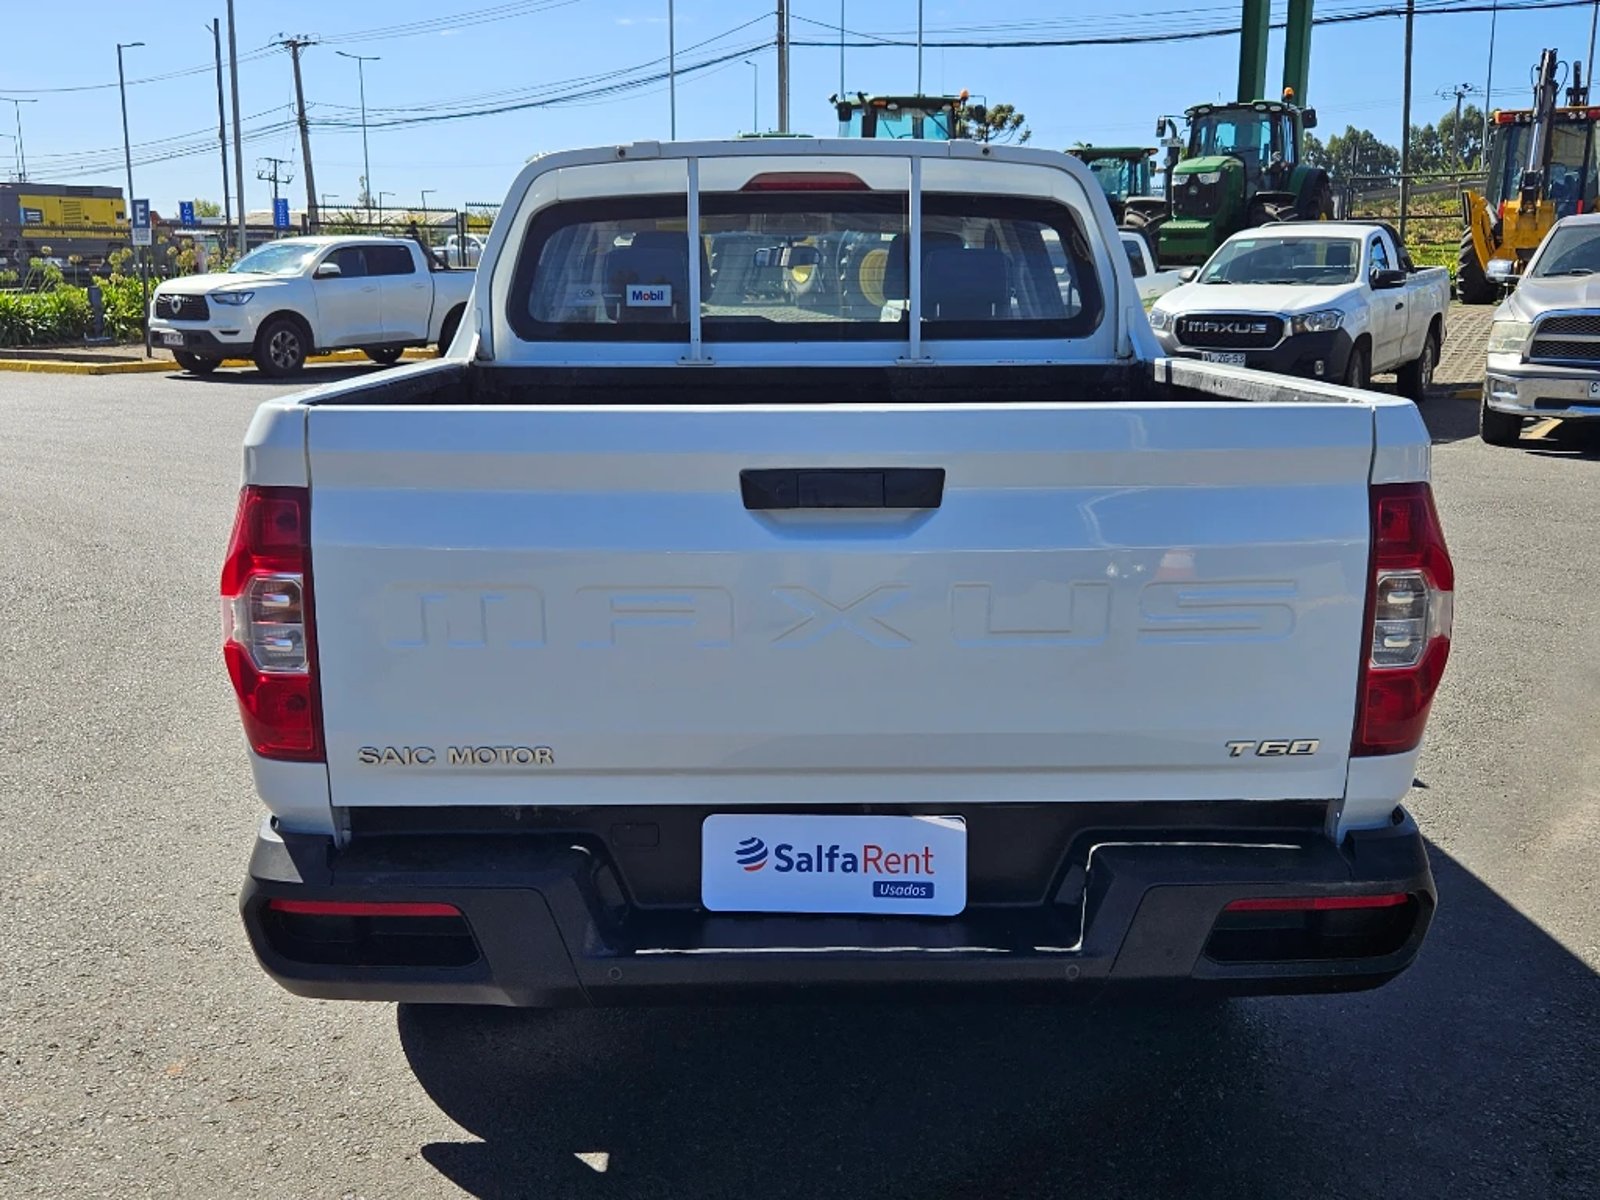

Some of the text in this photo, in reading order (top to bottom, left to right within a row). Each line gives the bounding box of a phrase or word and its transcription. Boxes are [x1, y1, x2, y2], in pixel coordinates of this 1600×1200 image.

[136, 204, 146, 225] E
[632, 290, 664, 301] Mobil
[1188, 321, 1267, 333] MAXUS
[384, 579, 1298, 648] MAXUS
[358, 746, 554, 765] SAIC MOTOR
[1225, 738, 1320, 757] T60
[878, 883, 928, 897] Usados
